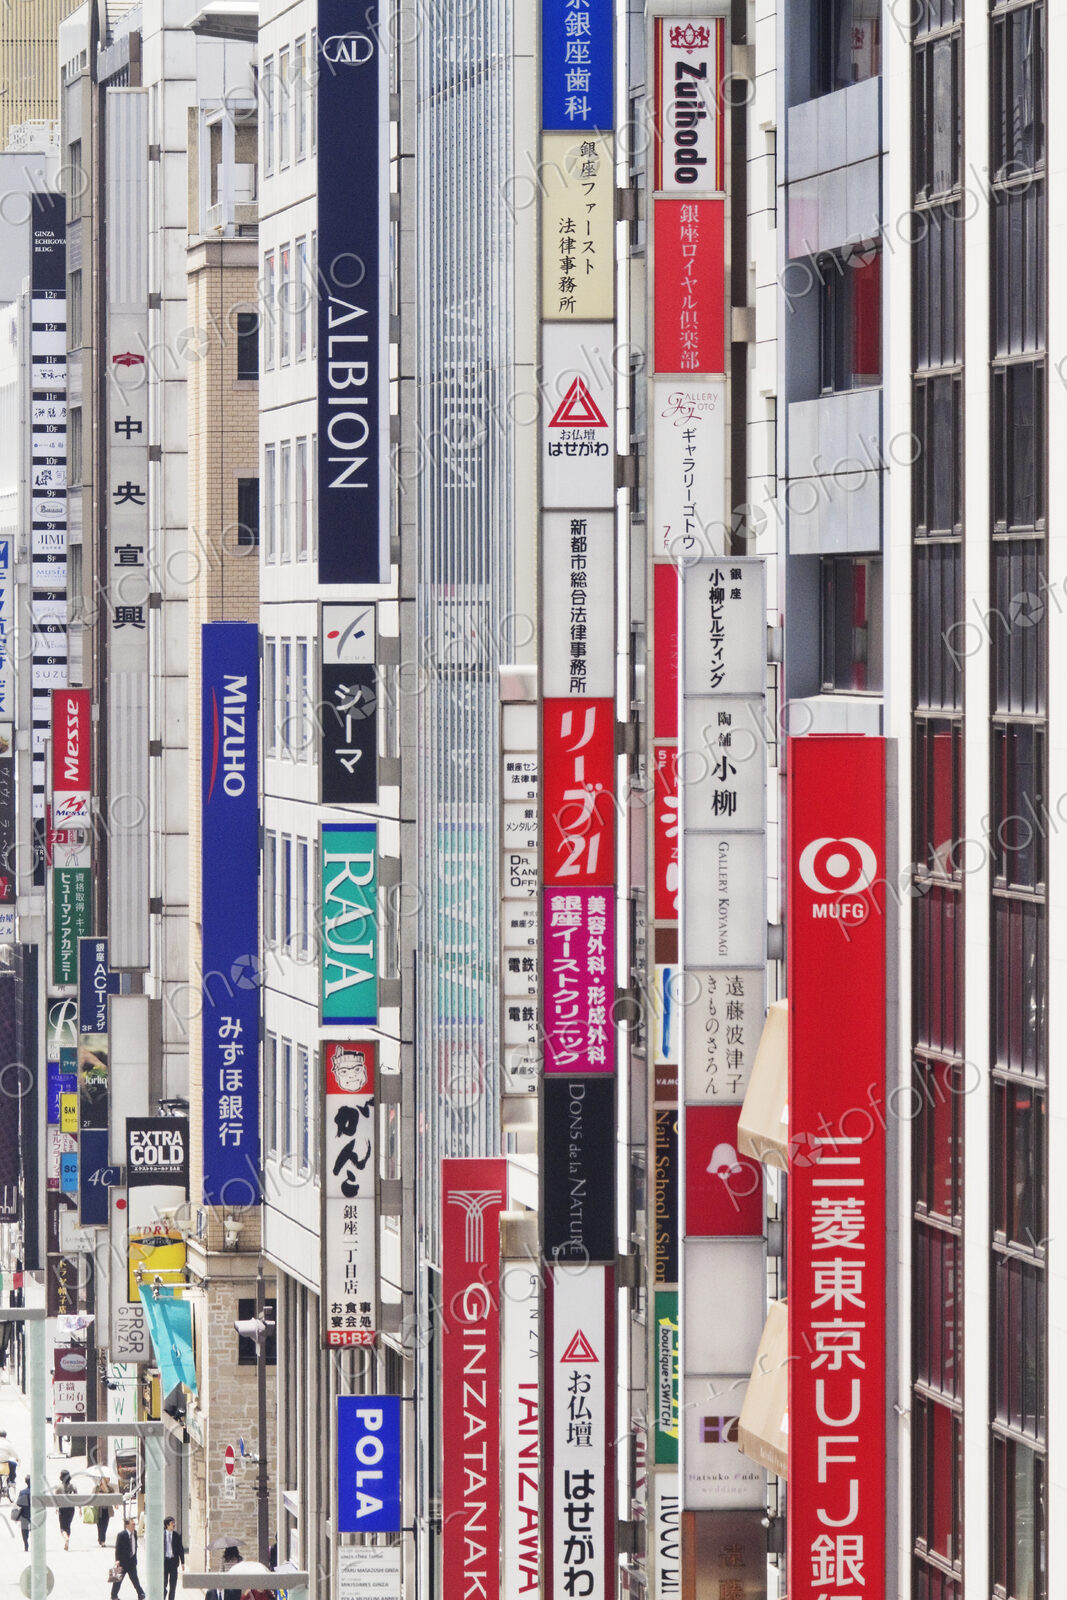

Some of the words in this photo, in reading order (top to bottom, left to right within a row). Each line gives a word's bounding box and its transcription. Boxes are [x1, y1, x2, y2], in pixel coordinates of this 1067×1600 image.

[673, 61, 708, 186] Zuihodo
[579, 139, 596, 276] 銀座ファースト
[558, 217, 577, 314] 法律事務所
[679, 203, 700, 370] 銀座ロイヤル倶楽部
[44, 291, 58, 299] 12F
[44, 323, 58, 331] 12F
[45, 356, 58, 364] 11F
[328, 296, 370, 489] ALBION
[46, 424, 58, 433] 10F
[548, 442, 609, 457] はせがわ
[559, 428, 596, 441] お仏壇
[46, 457, 58, 465] 10F
[681, 427, 697, 550] ギャラリーゴトウ
[46, 489, 57, 498] 9F
[112, 415, 147, 630] 中央宣興
[38, 534, 65, 544] JIMI
[46, 522, 57, 530] 9F
[46, 554, 57, 562] 8F
[729, 567, 742, 601] 銀座
[46, 592, 57, 600] 7F
[569, 519, 588, 694] 新都市総合法律事務所
[46, 624, 57, 632] 6F
[708, 568, 727, 690] 小柳ビルディング
[46, 656, 57, 664] 6F
[64, 698, 80, 782] Messe
[222, 674, 249, 799] MIZUHO
[334, 683, 364, 775] シーマ
[717, 712, 733, 748] 陶舗
[55, 809, 88, 818] Messe
[555, 706, 604, 878] リーブ21
[710, 756, 738, 818] 小柳
[718, 841, 731, 893] GALLERY
[61, 872, 74, 982] ヒューマンアカデミー
[324, 848, 376, 999] RAJA
[718, 898, 732, 957] KOYANAGI
[811, 902, 865, 919] MUFG
[94, 942, 107, 1032] 銀座ACTプラザ
[508, 957, 538, 973] 電鉄
[550, 896, 582, 1065] 銀座イーストクリニック
[587, 896, 606, 1064] 美容外科・形成外科
[81, 1024, 93, 1032] 3F
[508, 1006, 538, 1022] 電鉄
[705, 975, 719, 1095] きものさろん
[725, 975, 745, 1094] 遠藤波津子
[217, 1016, 244, 1147] みずほ銀行
[129, 1130, 184, 1146] EXTRA
[569, 1082, 586, 1140] DONS
[655, 1111, 671, 1146] Nail
[130, 1145, 185, 1165] COLD
[332, 1096, 376, 1198] がんこ
[655, 1153, 672, 1220] School
[569, 1178, 583, 1255] NATURE
[343, 1204, 359, 1295] 銀座一丁目店
[655, 1231, 671, 1285] Salon
[118, 1306, 129, 1354] GINZA
[129, 1306, 145, 1354] PRGR
[331, 1302, 372, 1315] お食事
[331, 1316, 373, 1329] 宴会処
[810, 1137, 867, 1600] 三菱東京UFJ銀
[566, 1370, 593, 1448] お仏壇
[355, 1408, 385, 1520] POLA
[563, 1469, 595, 1597] はせがわ
